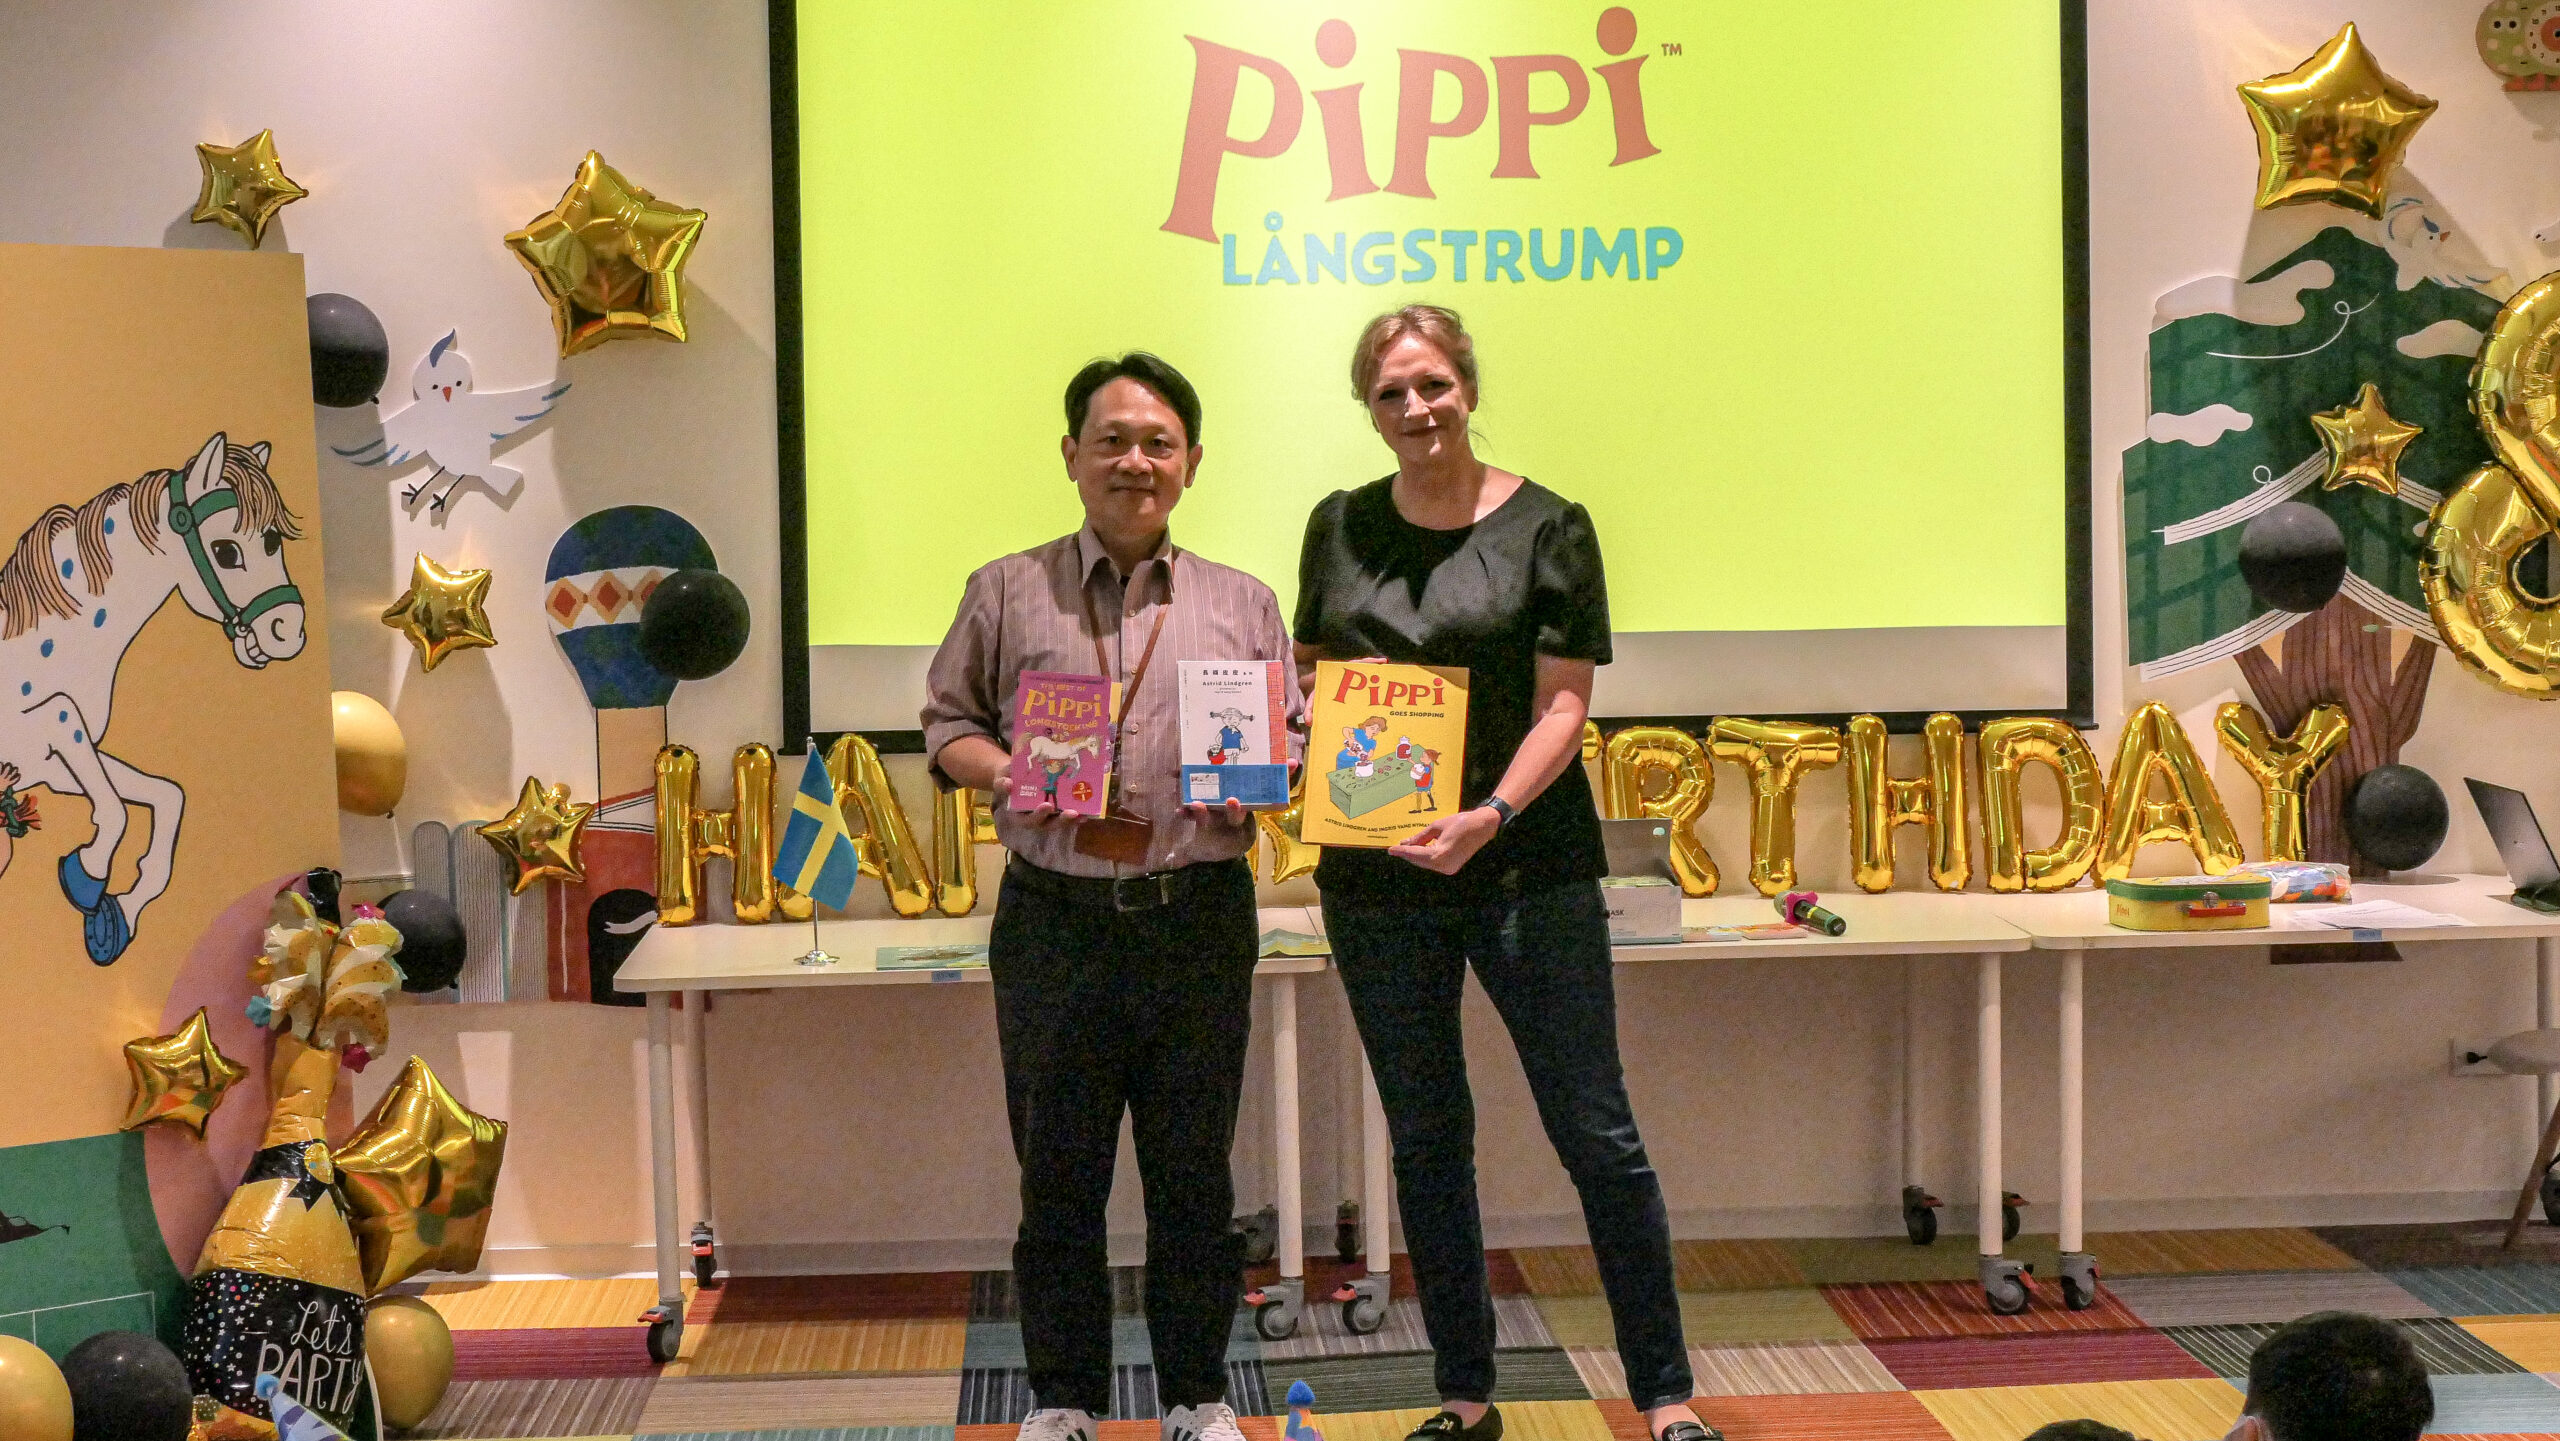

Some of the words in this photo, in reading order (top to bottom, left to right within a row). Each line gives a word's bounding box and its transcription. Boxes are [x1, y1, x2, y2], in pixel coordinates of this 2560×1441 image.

[1222, 211, 1684, 286] LÅNGSTRUMP
[1582, 701, 2351, 898] RTHDAY
[290, 1300, 353, 1356] Let's
